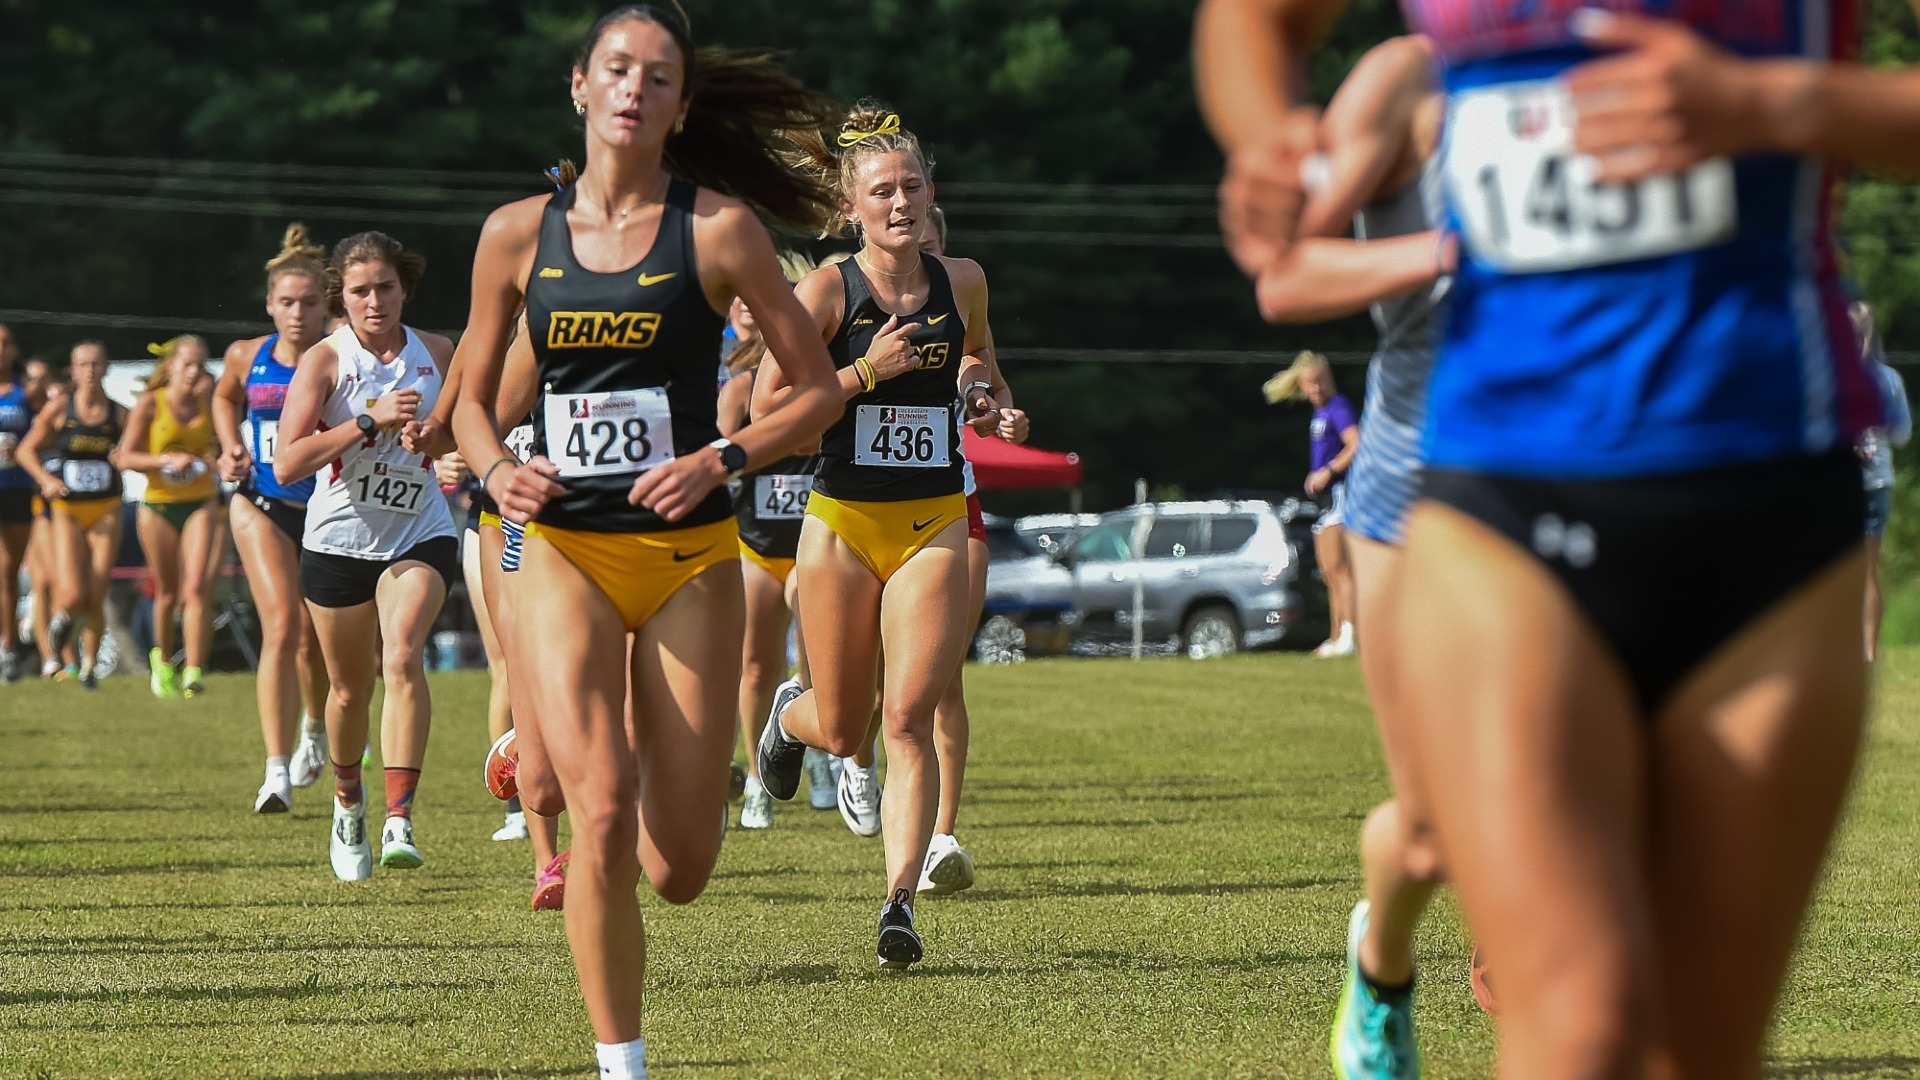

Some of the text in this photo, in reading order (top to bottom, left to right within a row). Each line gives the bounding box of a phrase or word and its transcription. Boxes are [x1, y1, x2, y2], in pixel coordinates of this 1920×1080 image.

[548, 312, 661, 349] RAMS
[566, 418, 652, 467] 428
[870, 426, 934, 462] 436
[357, 475, 423, 510] 1427
[766, 490, 811, 515] 429
